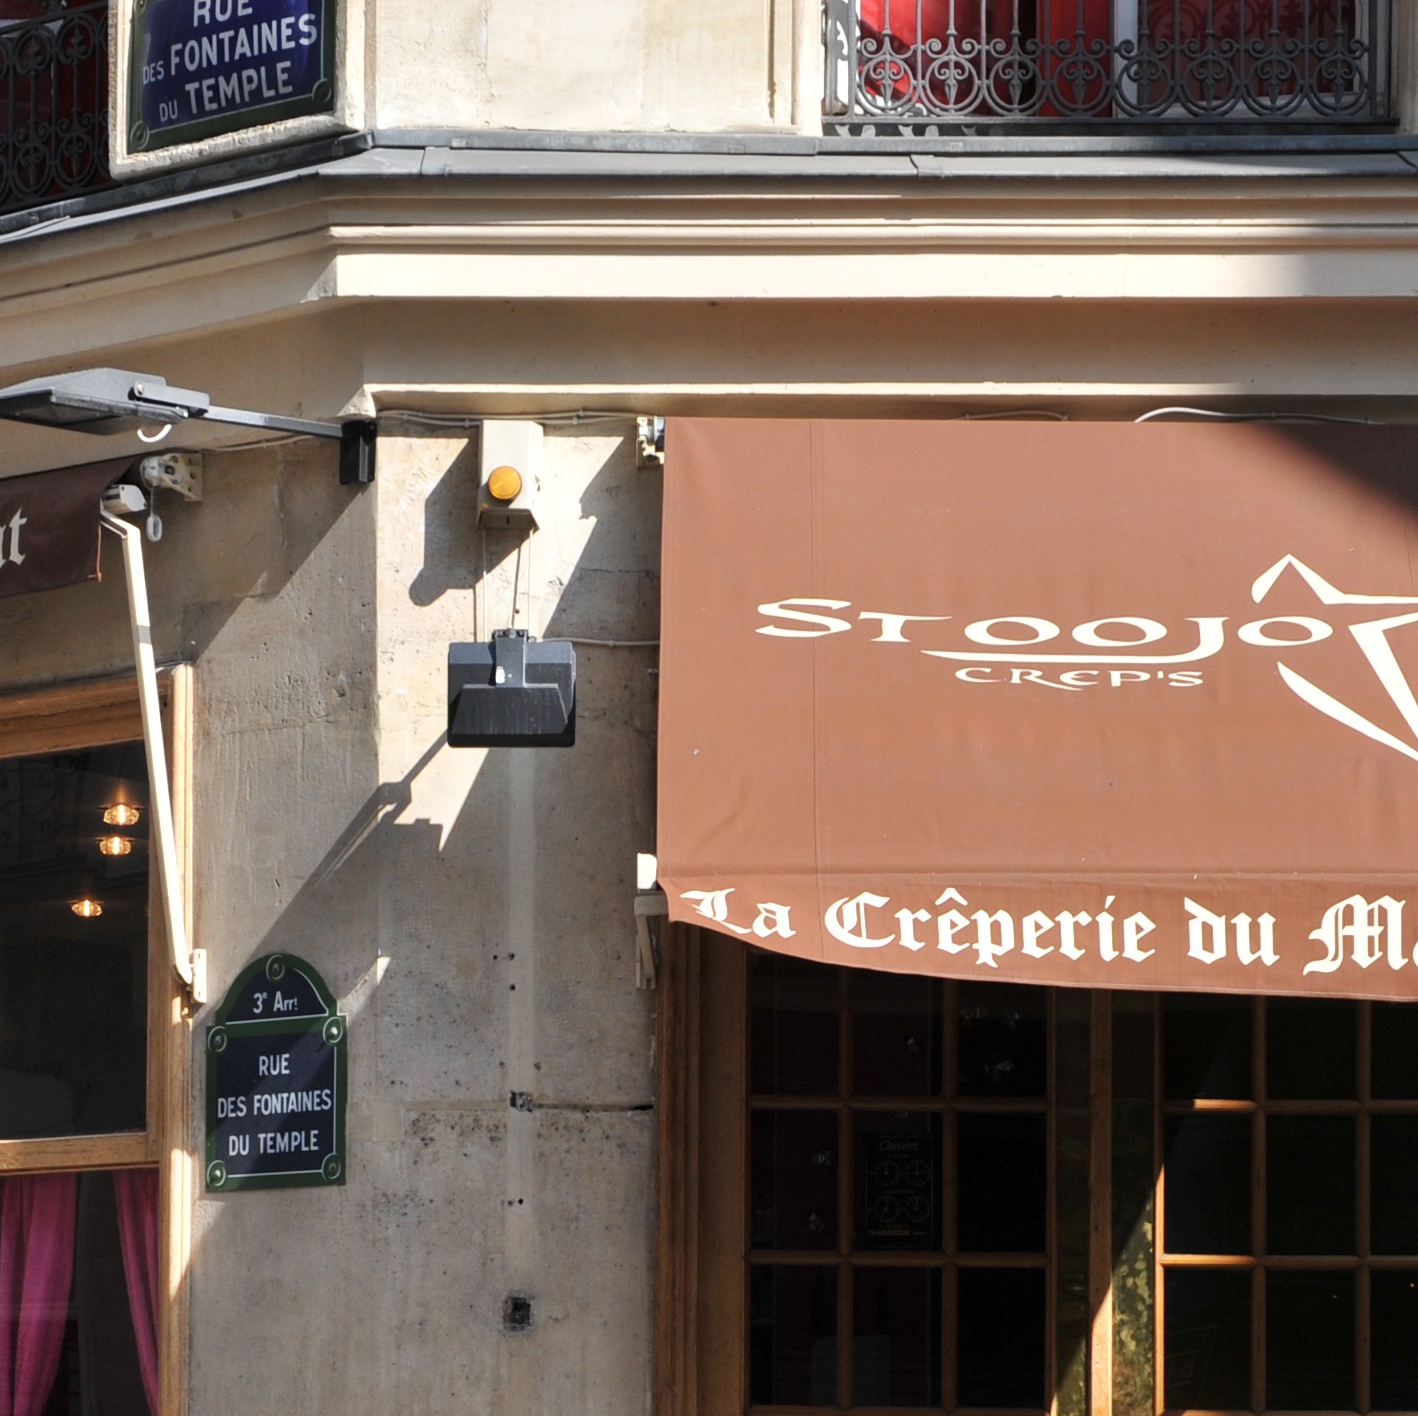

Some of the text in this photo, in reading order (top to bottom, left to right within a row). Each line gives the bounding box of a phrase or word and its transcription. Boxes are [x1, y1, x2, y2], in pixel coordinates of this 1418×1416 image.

[193, 0, 253, 27] RUE
[142, 13, 317, 85] DES FONTAINES
[159, 61, 293, 122] DU TEMPLE
[680, 887, 797, 939] La
[824, 887, 1157, 968] Crêperie
[1184, 896, 1280, 967] du
[259, 1053, 290, 1076] RUE
[217, 1089, 332, 1118] DES FONTAINES
[229, 1130, 319, 1156] DU TEMPLE
